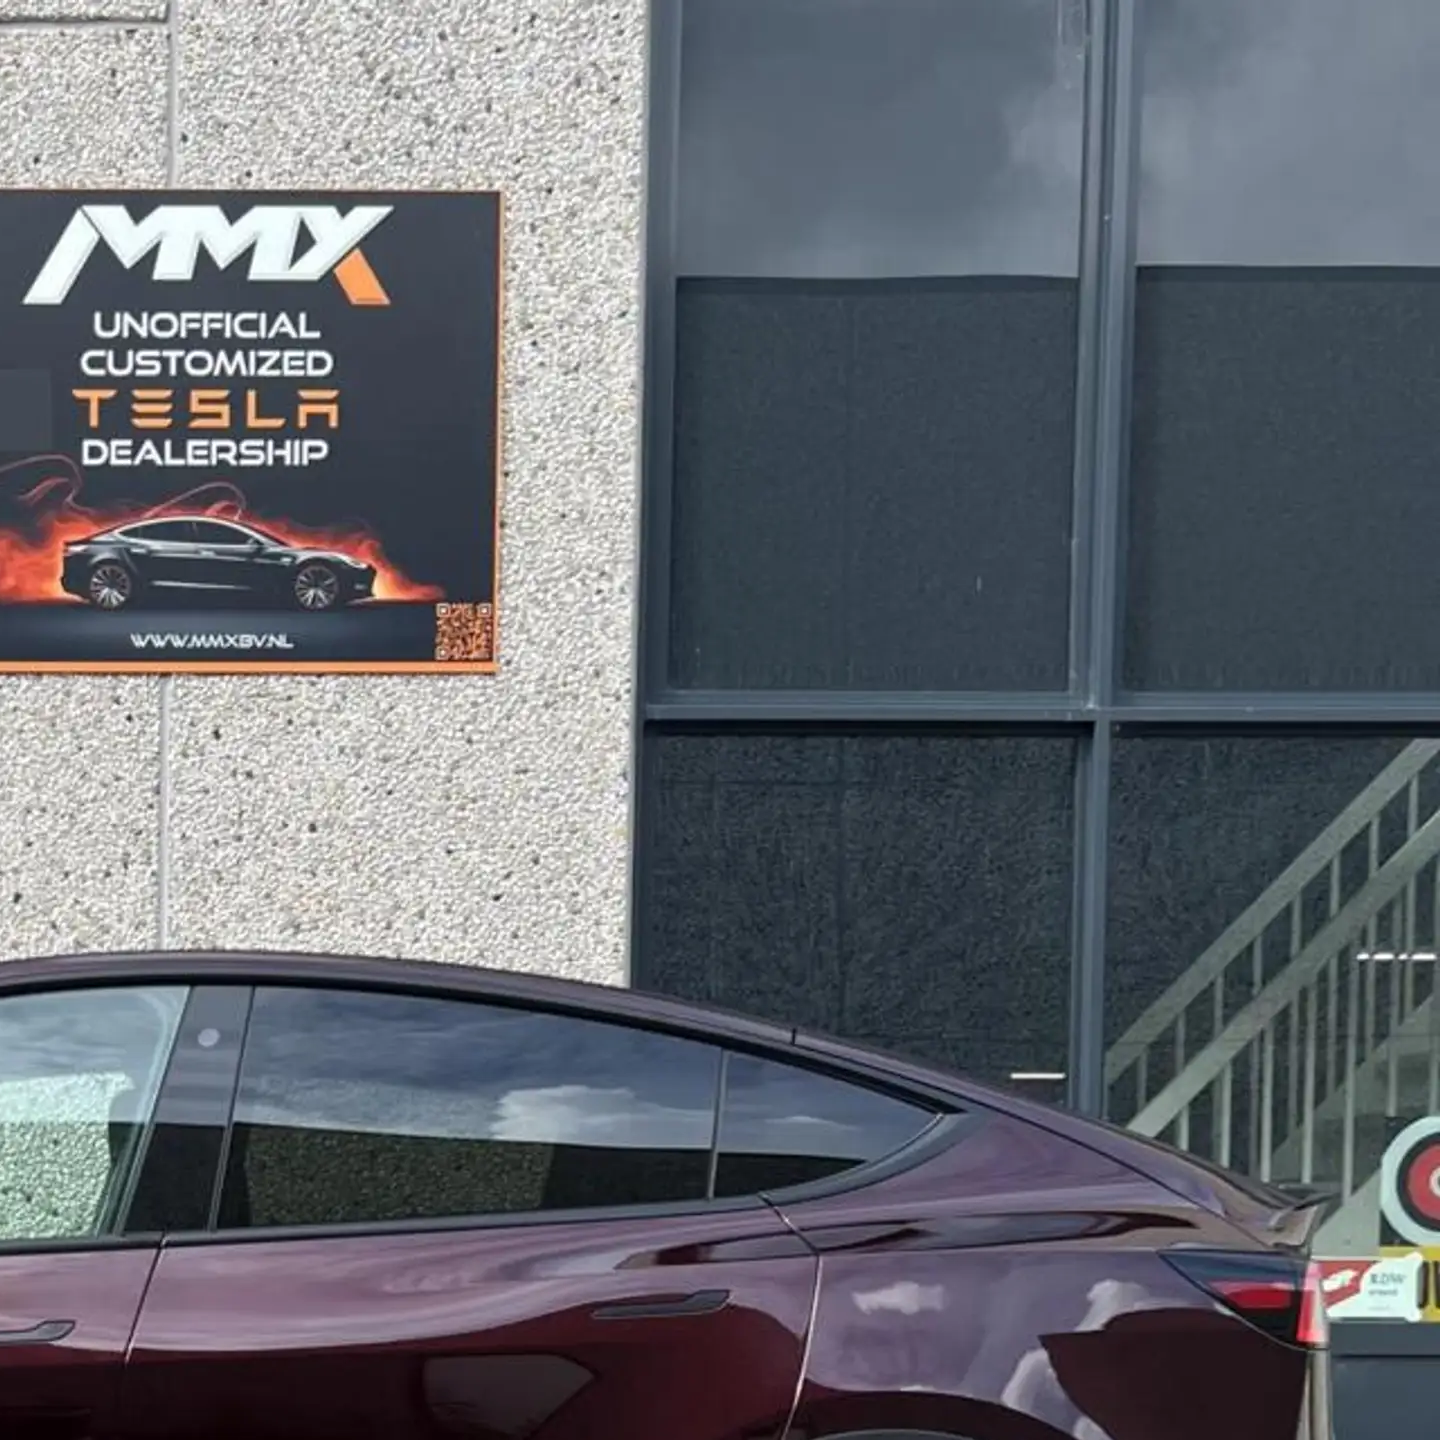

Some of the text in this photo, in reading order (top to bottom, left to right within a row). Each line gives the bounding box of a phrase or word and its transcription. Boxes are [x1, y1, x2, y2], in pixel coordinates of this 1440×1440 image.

[23, 205, 394, 305] MMX
[93, 311, 321, 338] UNOFFICIAL
[80, 350, 334, 377] CUSTOMIZED
[71, 389, 341, 429] TESLA
[80, 438, 329, 466] DEALERSHIP
[130, 633, 294, 649] WWW.MMXBV.NL
